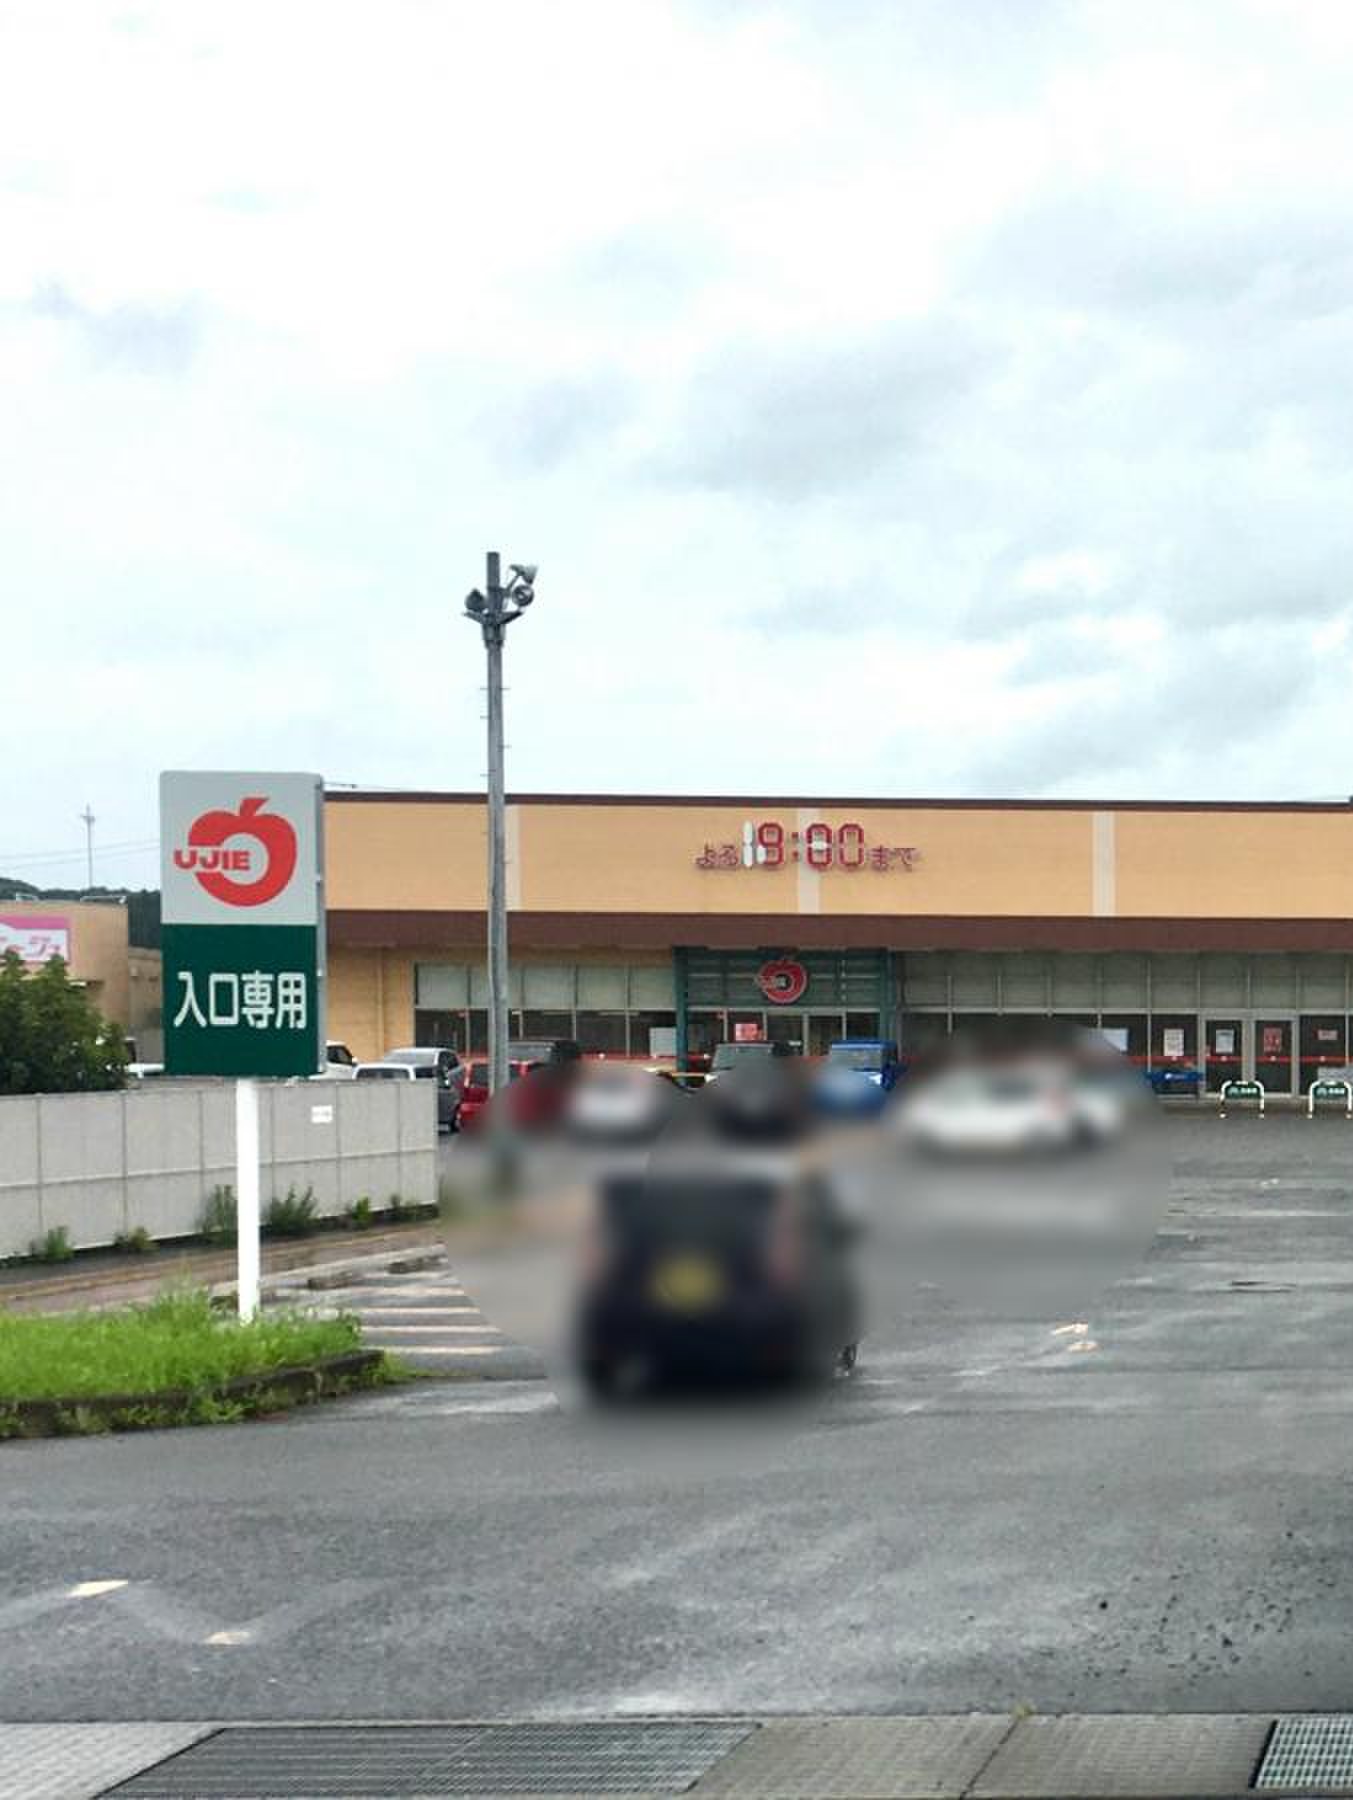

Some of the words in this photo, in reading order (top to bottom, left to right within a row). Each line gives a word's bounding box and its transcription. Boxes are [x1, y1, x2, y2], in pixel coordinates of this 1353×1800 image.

[174, 850, 250, 870] UJIE
[173, 971, 307, 1029] 入口専用
